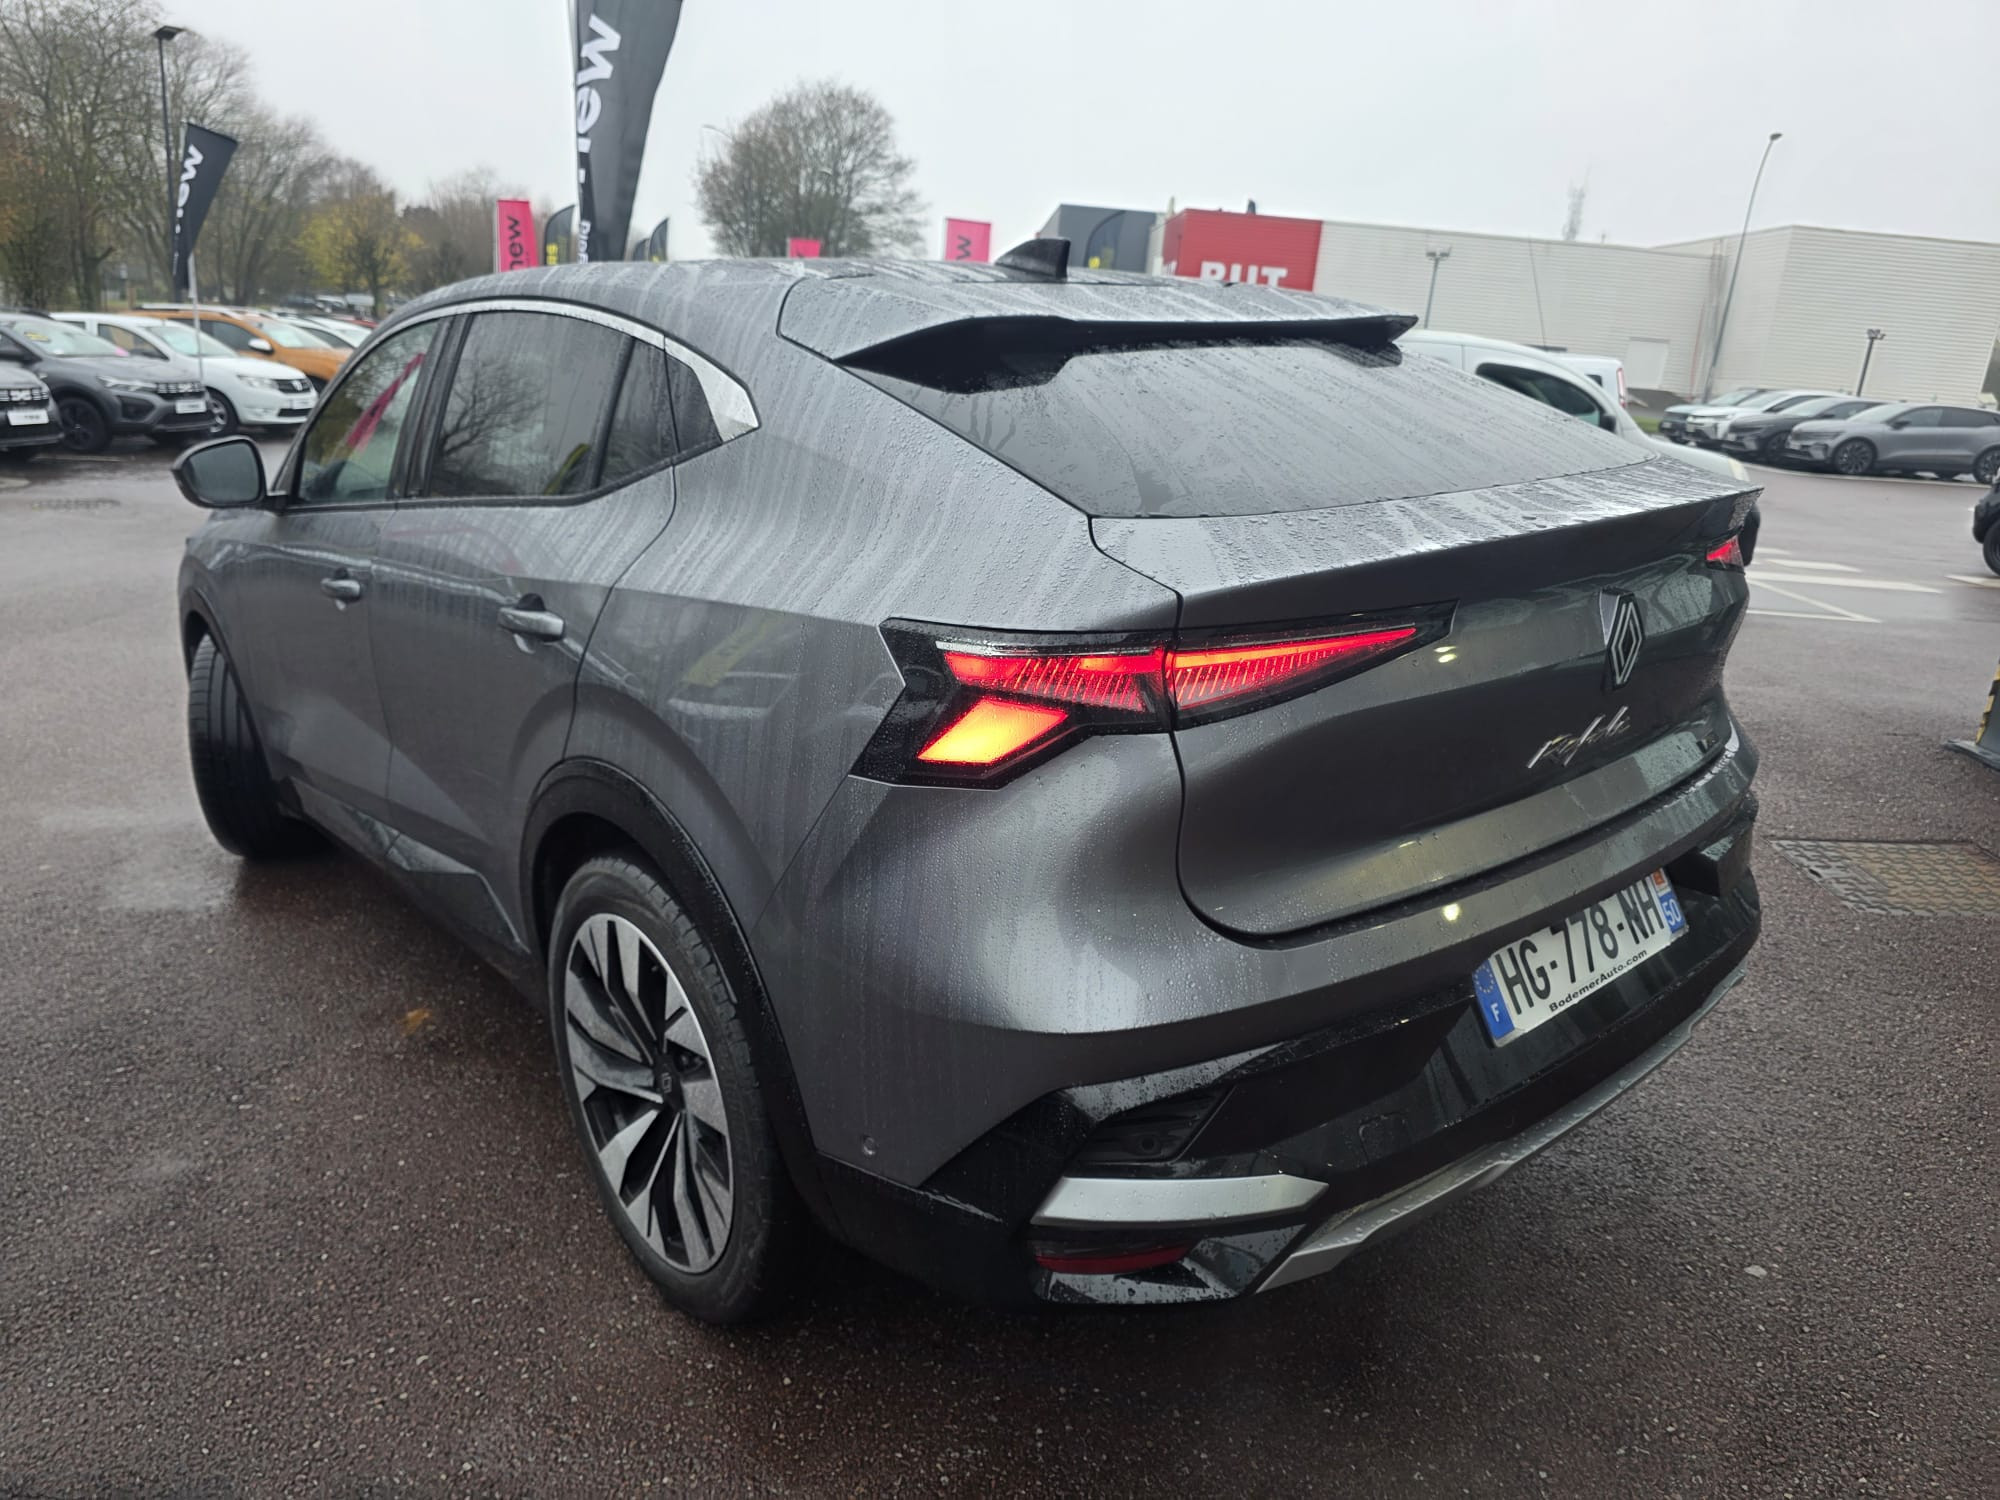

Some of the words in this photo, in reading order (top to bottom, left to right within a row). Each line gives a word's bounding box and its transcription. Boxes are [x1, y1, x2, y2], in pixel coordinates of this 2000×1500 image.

[1662, 899, 1682, 926] 50
[1494, 876, 1665, 1016] HG-778-NH
[1548, 949, 1648, 1012] BodemerAuto.com
[1490, 1002, 1501, 1023] F
